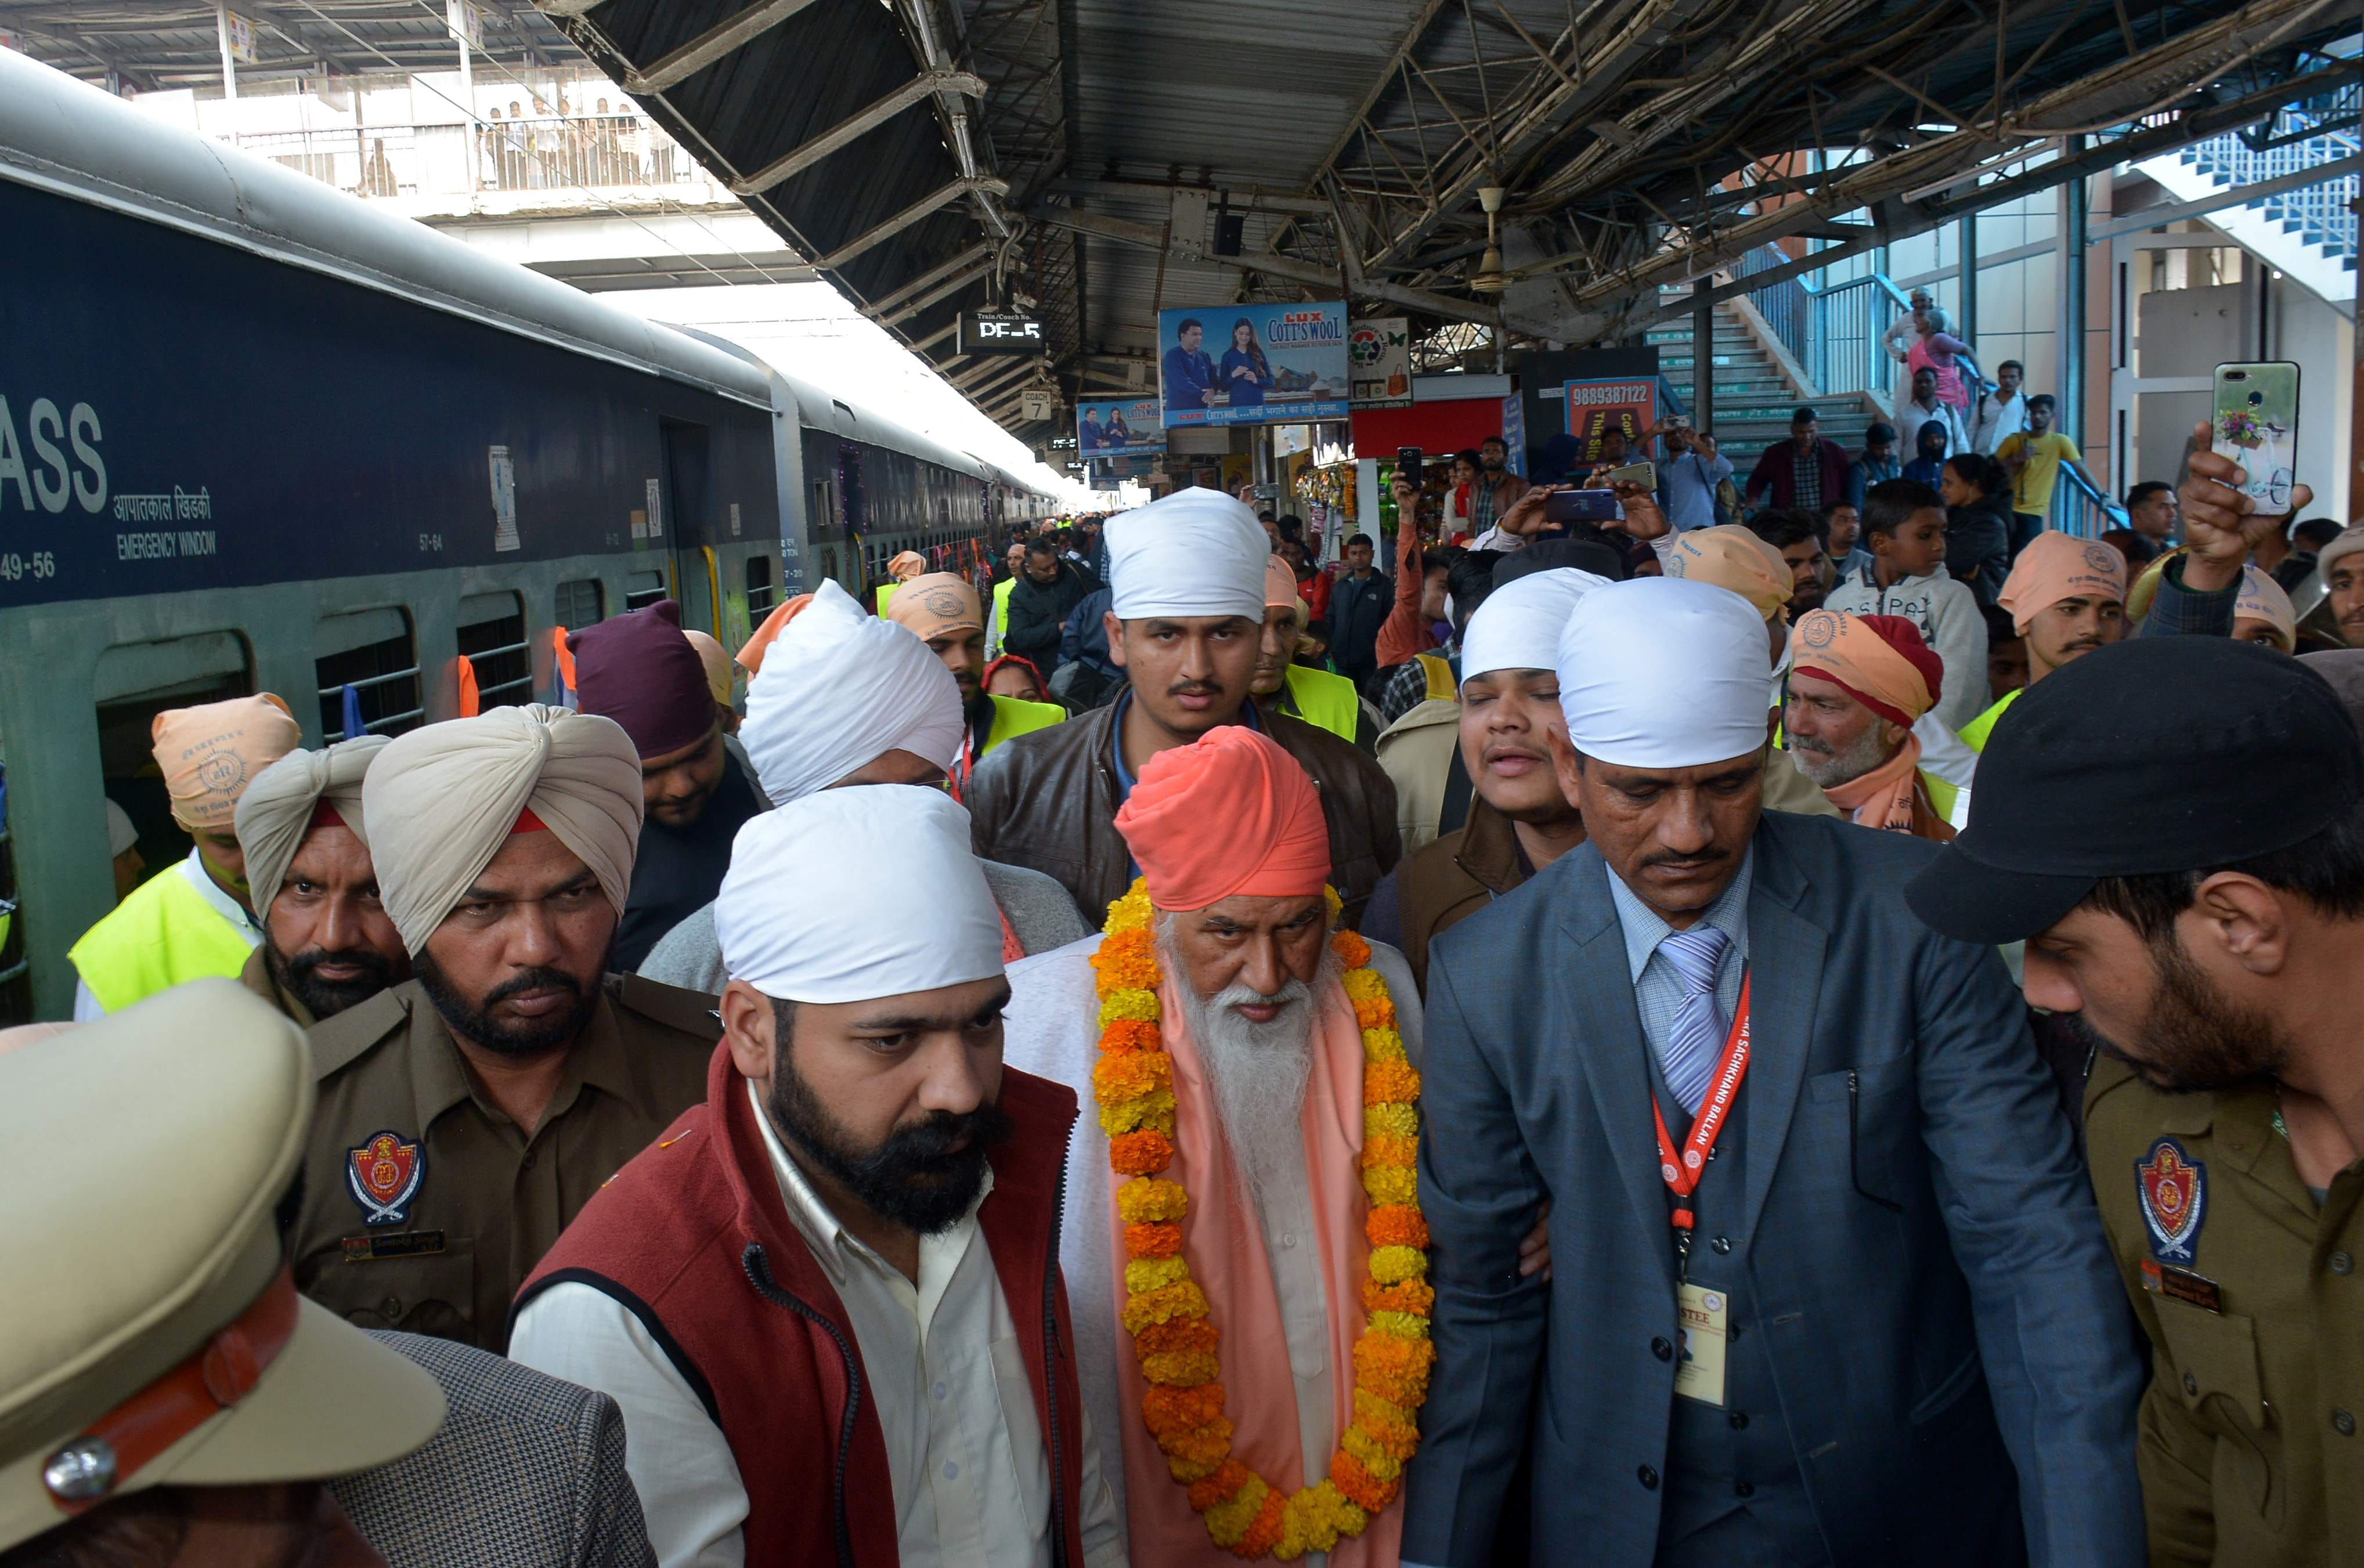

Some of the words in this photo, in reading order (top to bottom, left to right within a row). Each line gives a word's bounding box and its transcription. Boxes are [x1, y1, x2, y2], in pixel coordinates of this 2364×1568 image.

[1285, 312, 1323, 323] LUX
[1025, 393, 1048, 401] COACH
[1573, 384, 1648, 406] 9889387122
[1031, 403, 1041, 418] 7
[1590, 411, 1607, 436] This
[1586, 439, 1602, 461] Site
[117, 532, 176, 561] EMERGENCY
[179, 530, 216, 555] WINDOW
[418, 533, 443, 552] 57-64
[0, 552, 55, 580] 49-56
[1715, 1039, 1749, 1105] SACHKHAND
[1695, 1106, 1722, 1146] BALLAN
